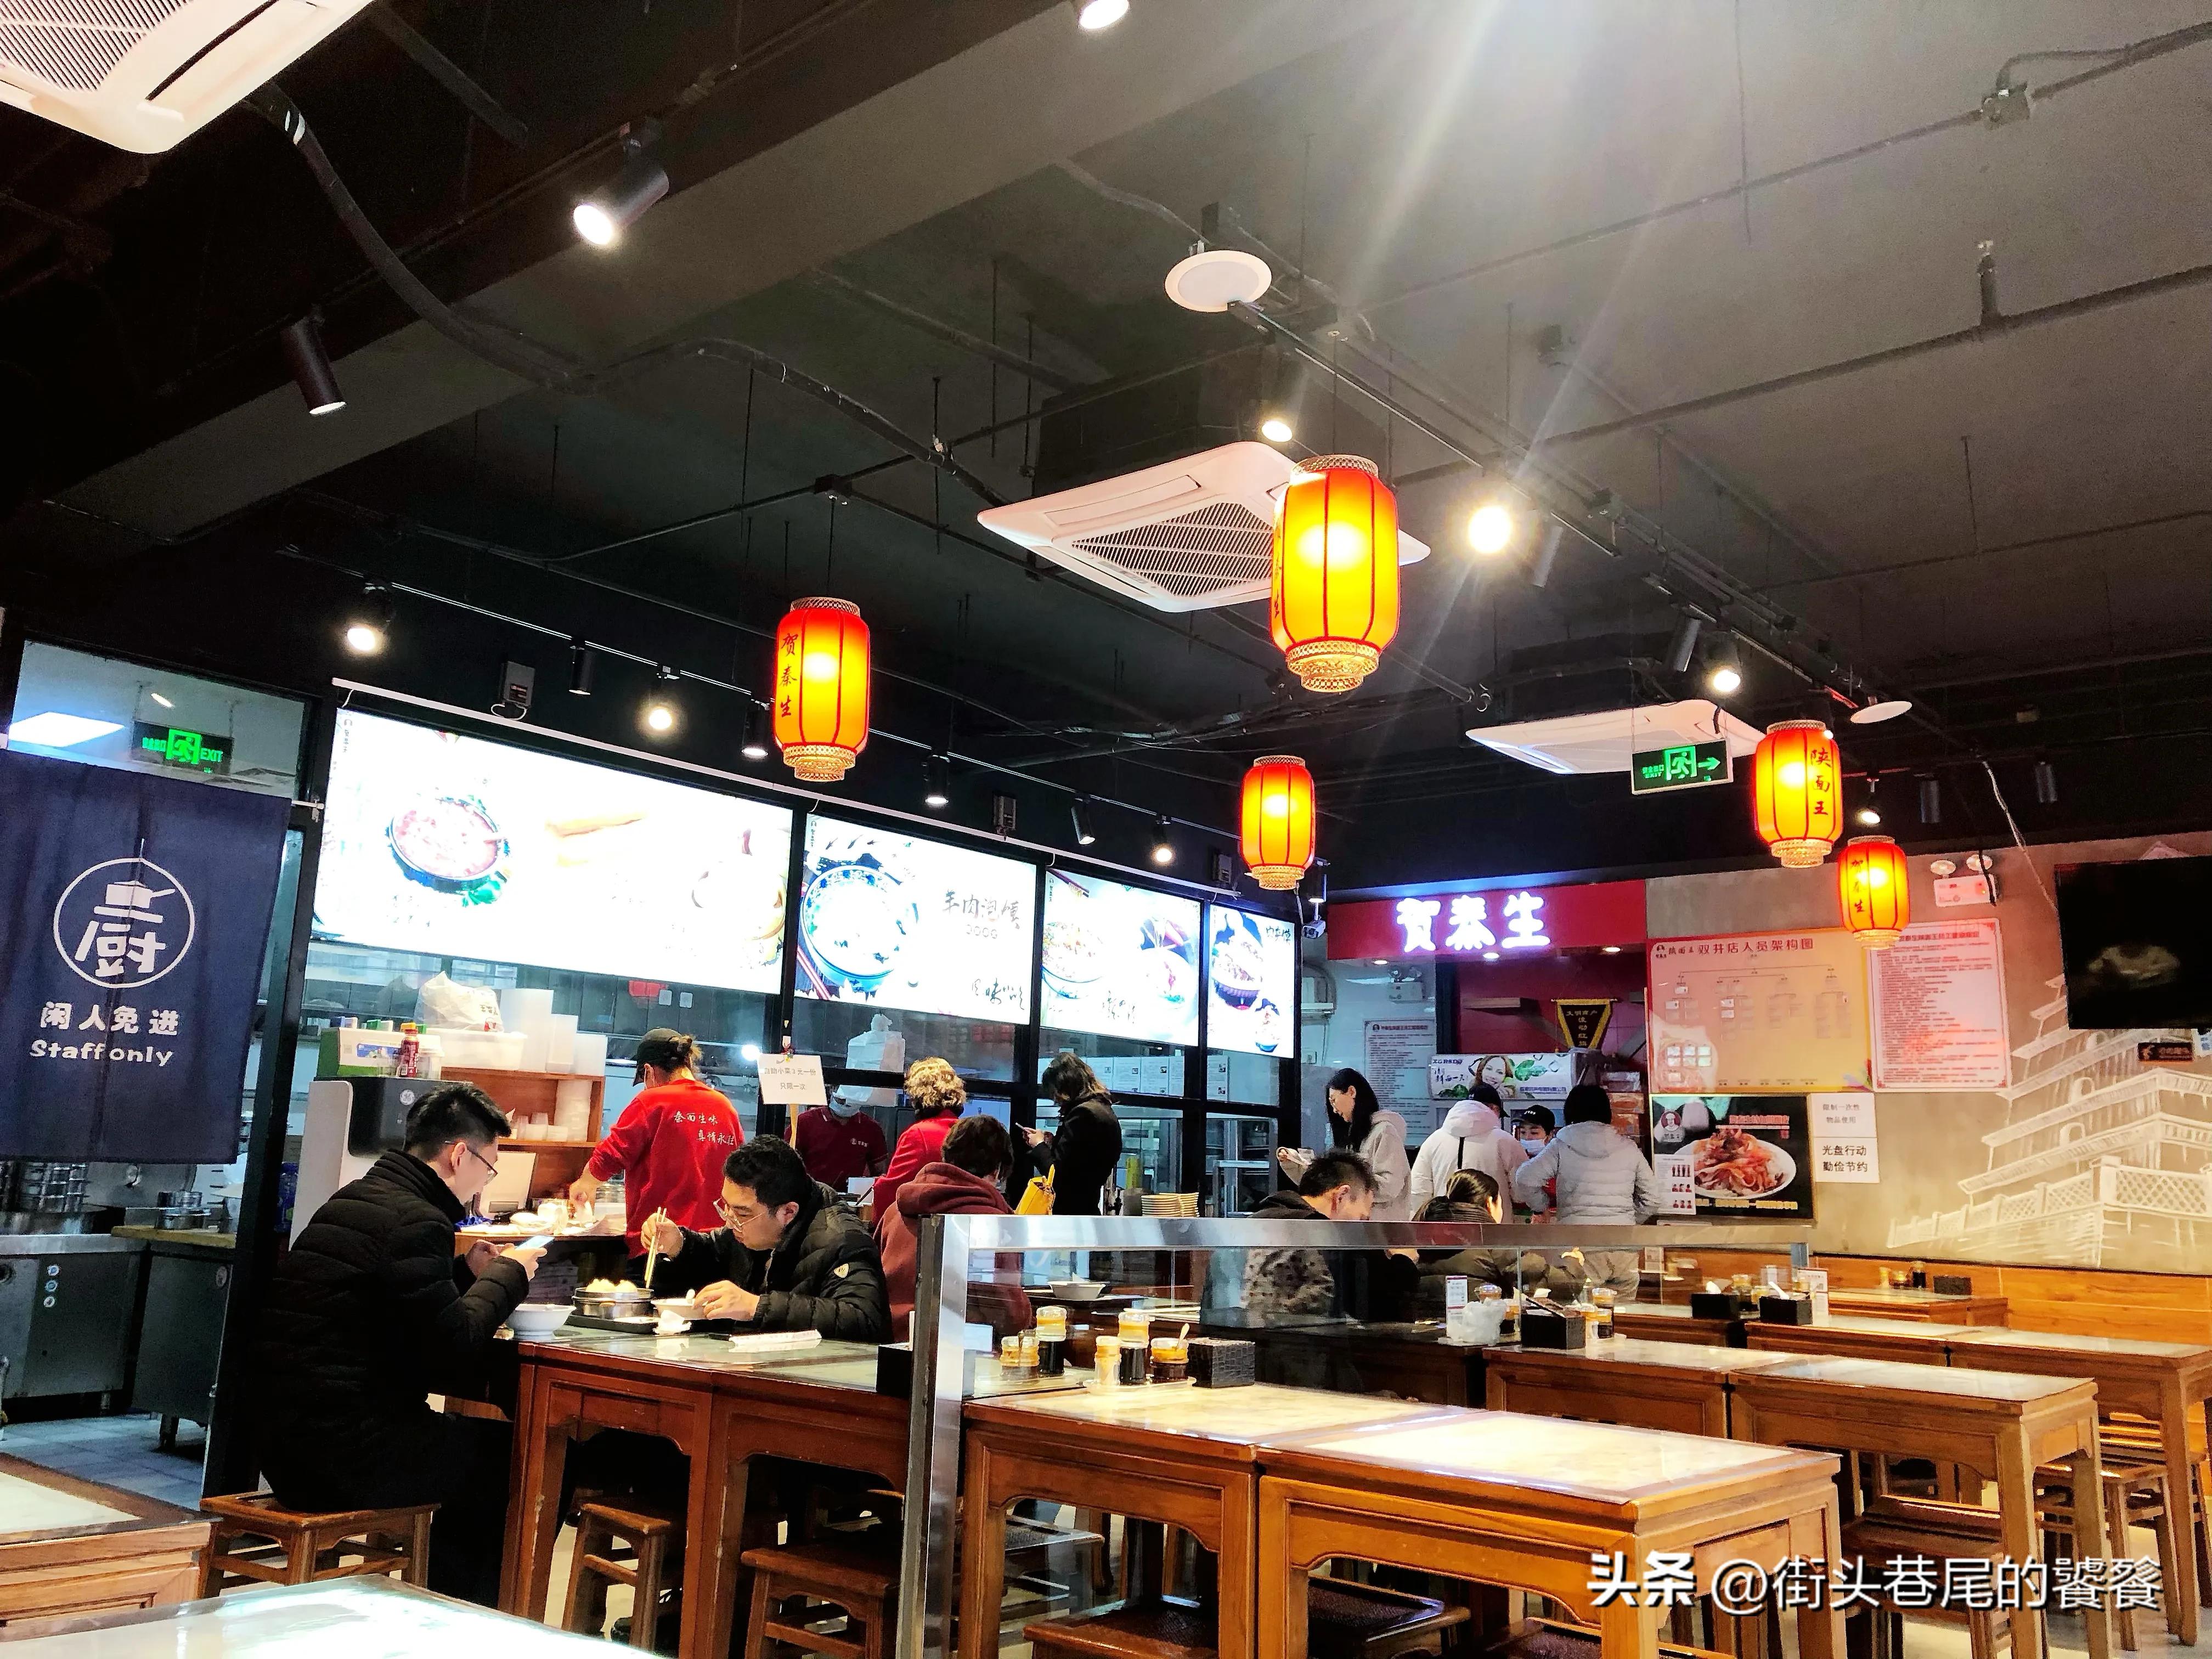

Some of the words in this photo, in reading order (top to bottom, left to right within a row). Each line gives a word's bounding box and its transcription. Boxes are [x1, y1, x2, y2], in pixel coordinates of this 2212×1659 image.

[780, 633, 799, 718] 贺秦生
[201, 748, 223, 763] EXIT
[1810, 747, 1832, 815] 陕面王
[40, 1001, 179, 1036] 闲人免进
[30, 1039, 106, 1060] Staff
[109, 1046, 173, 1067] only
[1822, 1145, 1867, 1156] 光盘行动
[1822, 1161, 1868, 1172] 勤俭节约
